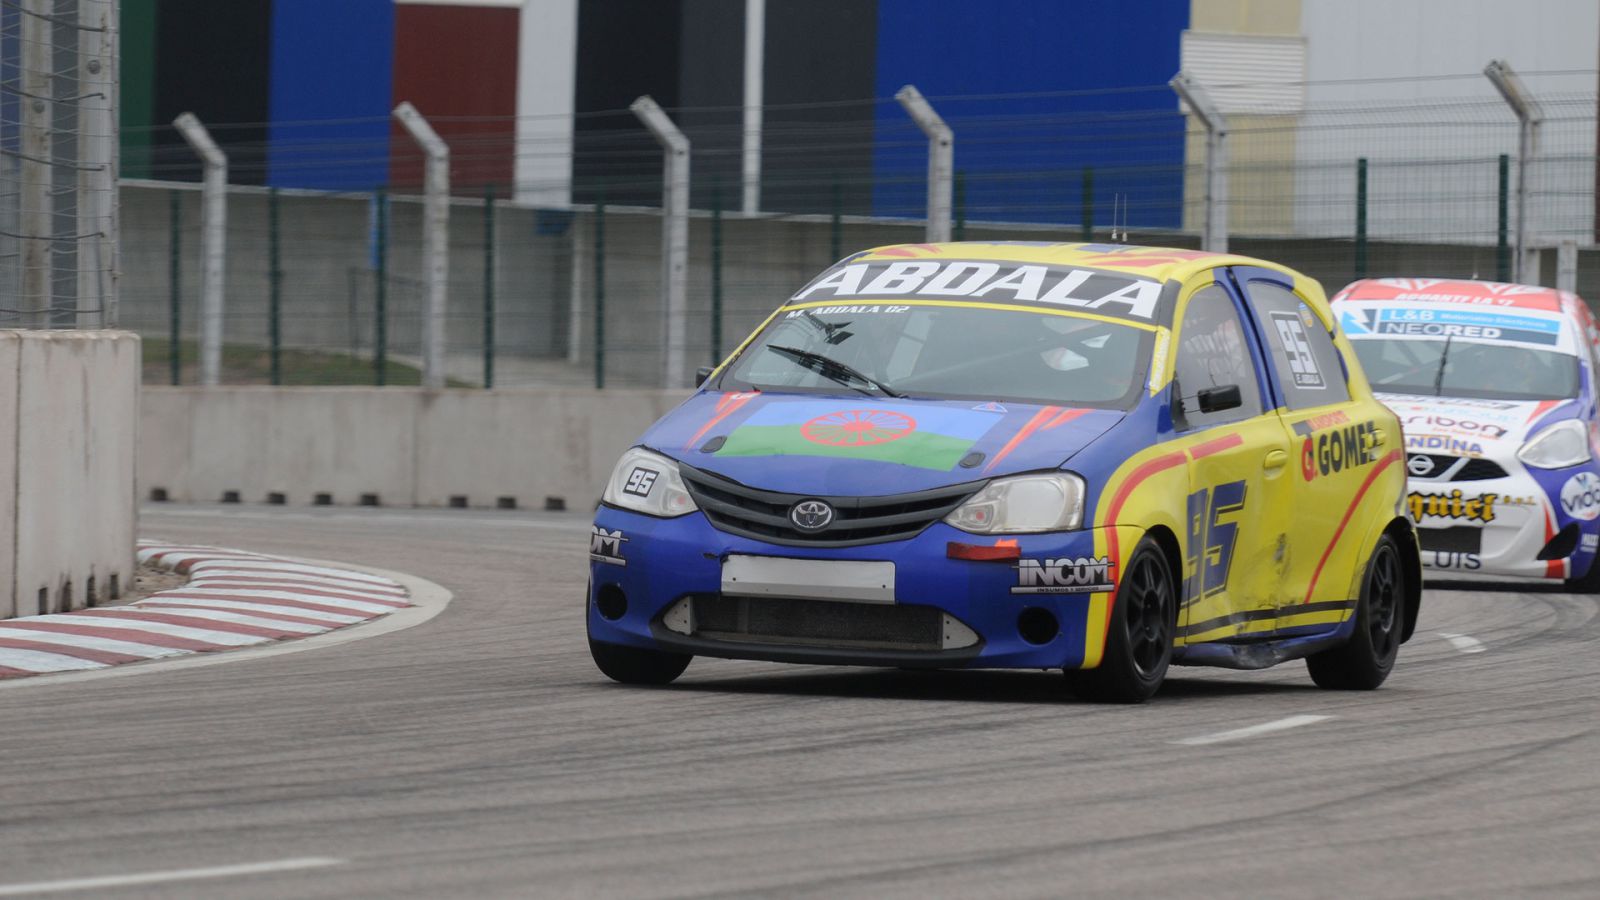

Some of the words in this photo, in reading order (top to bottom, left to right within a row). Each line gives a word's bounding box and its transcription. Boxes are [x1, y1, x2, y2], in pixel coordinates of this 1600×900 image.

[791, 261, 1163, 319] ABDALA
[809, 305, 880, 316] ABDALA
[1389, 309, 1435, 321] L&B
[1384, 322, 1502, 339] NEORED
[1273, 319, 1318, 374] 95
[1401, 415, 1504, 437] ribon
[1407, 436, 1484, 454] NDINA
[624, 469, 658, 495] 95
[1180, 479, 1248, 609] 95
[1018, 557, 1108, 586] INCOM
[1422, 551, 1482, 570] UIS
